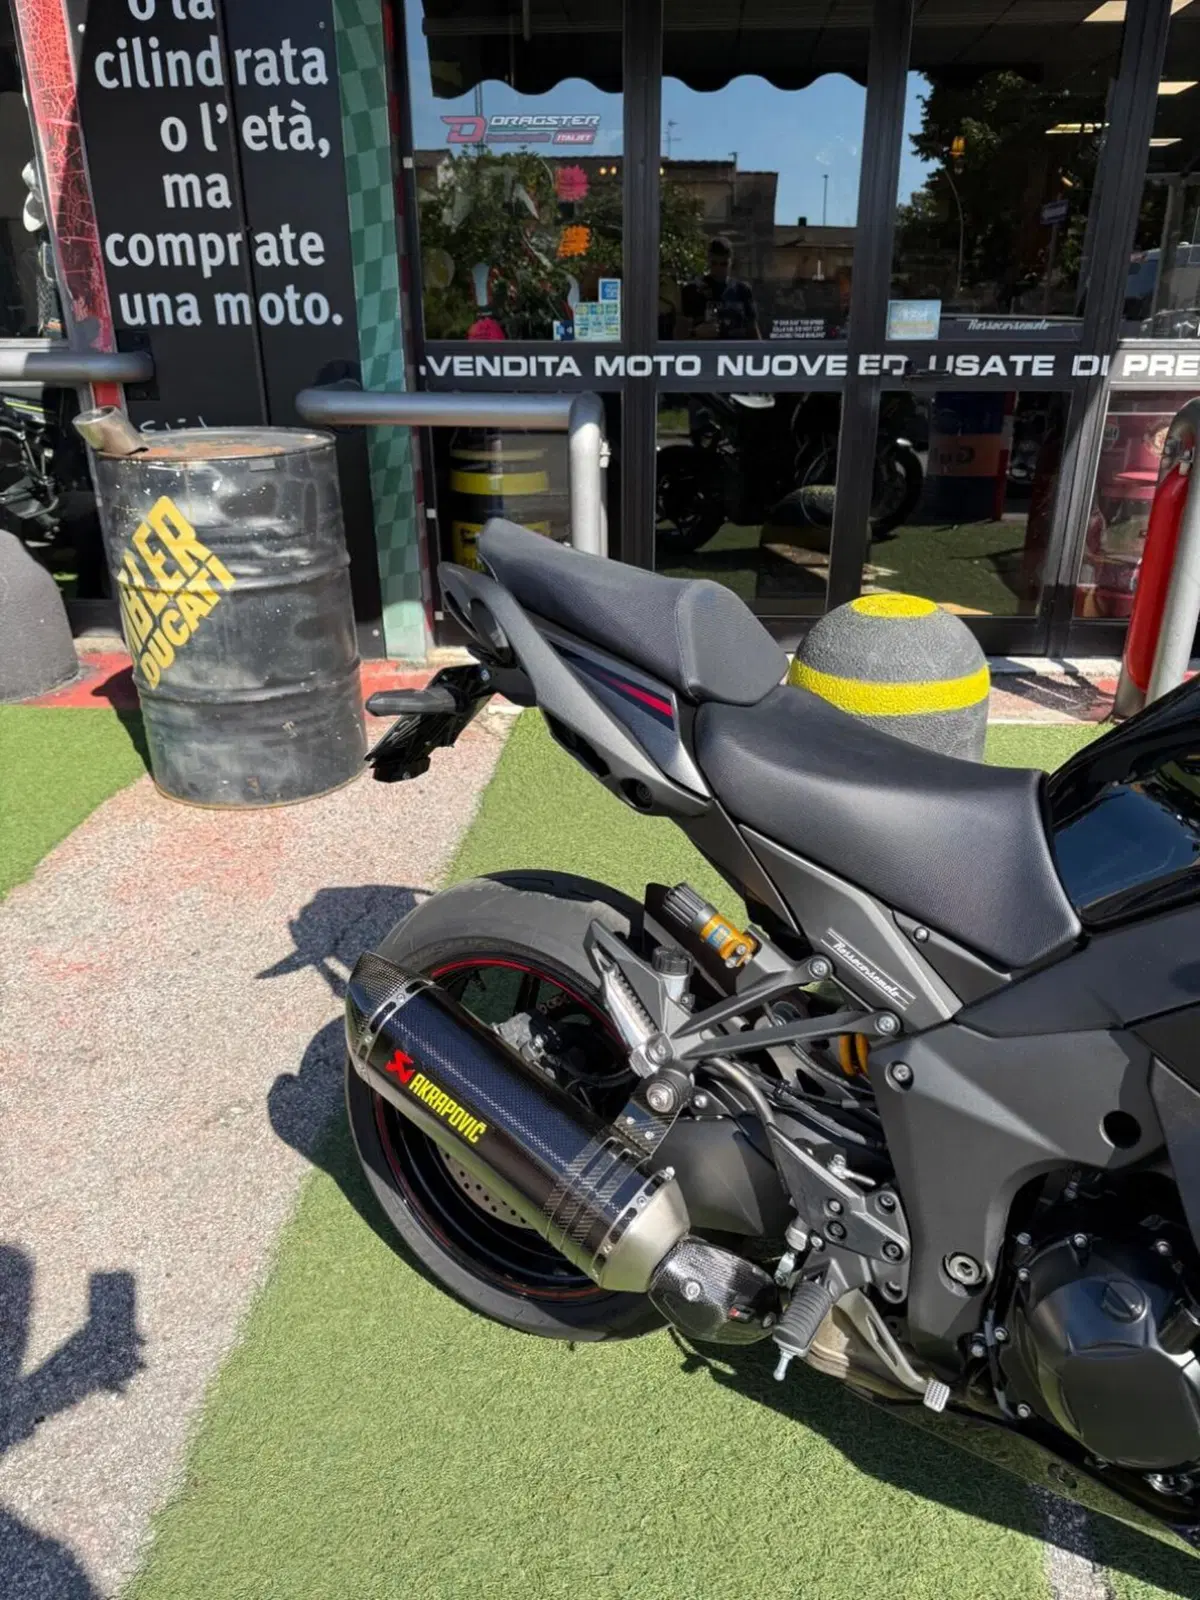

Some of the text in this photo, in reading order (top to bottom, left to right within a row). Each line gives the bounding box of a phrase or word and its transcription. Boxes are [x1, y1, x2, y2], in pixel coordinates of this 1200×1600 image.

[160, 115, 188, 152] o
[490, 115, 601, 126] DRAGSTER
[162, 172, 232, 209] ma
[105, 224, 325, 278] comprate
[119, 284, 343, 326] una moto.
[426, 356, 582, 377] VENDITA
[594, 355, 701, 377] MOTO
[717, 355, 848, 377] NUOVE
[1071, 355, 1110, 377] DI
[140, 555, 236, 690] DUCATI
